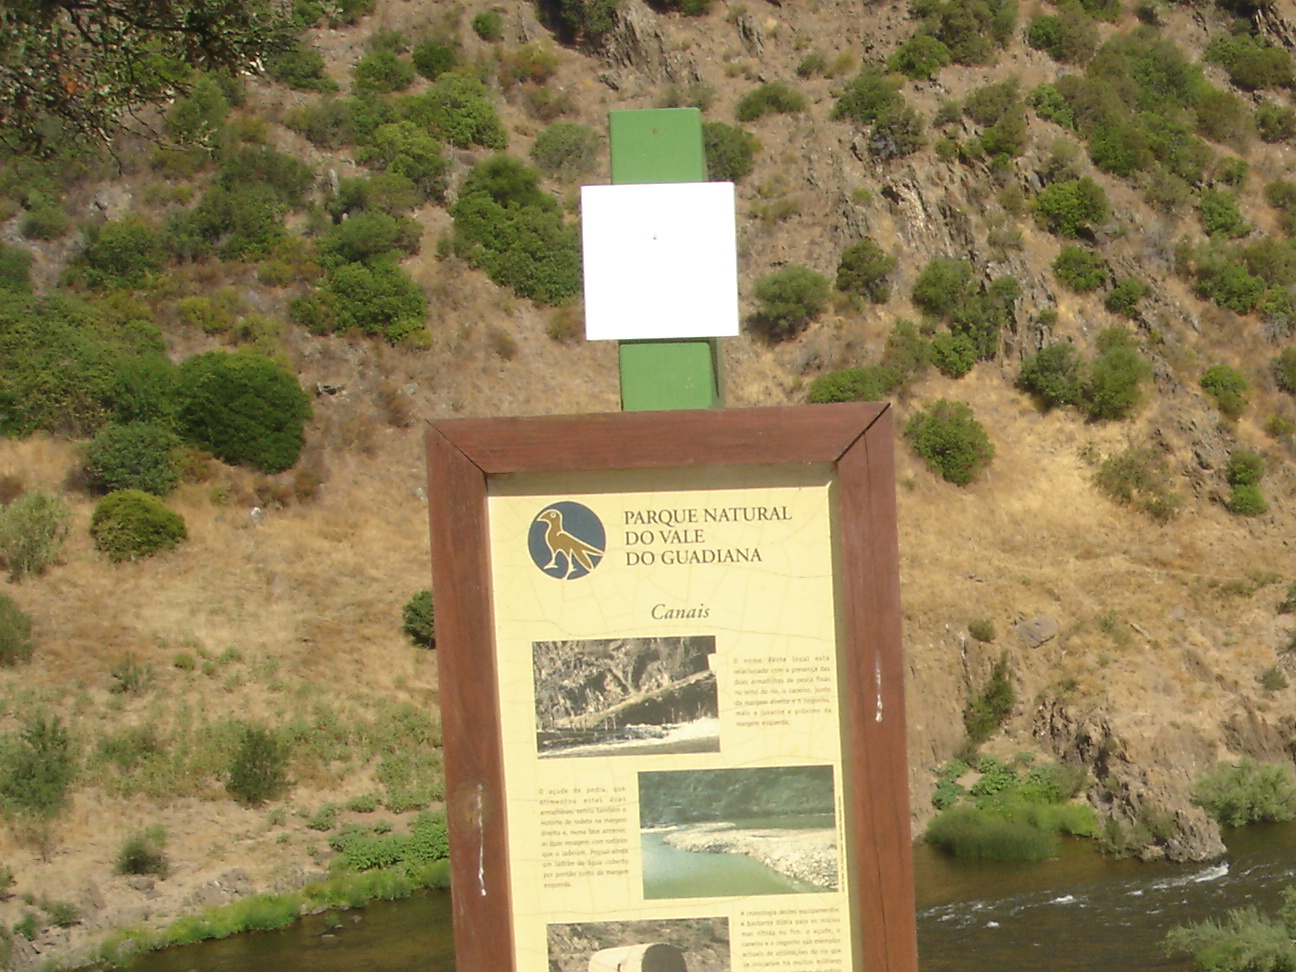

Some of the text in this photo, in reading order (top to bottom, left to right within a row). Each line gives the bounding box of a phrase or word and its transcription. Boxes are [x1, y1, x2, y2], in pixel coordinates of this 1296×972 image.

[624, 506, 793, 527] PARQUE NATURAL
[625, 529, 706, 546] DO VALE
[626, 548, 763, 566] DO GUADIANA
[651, 603, 710, 620] Canais
